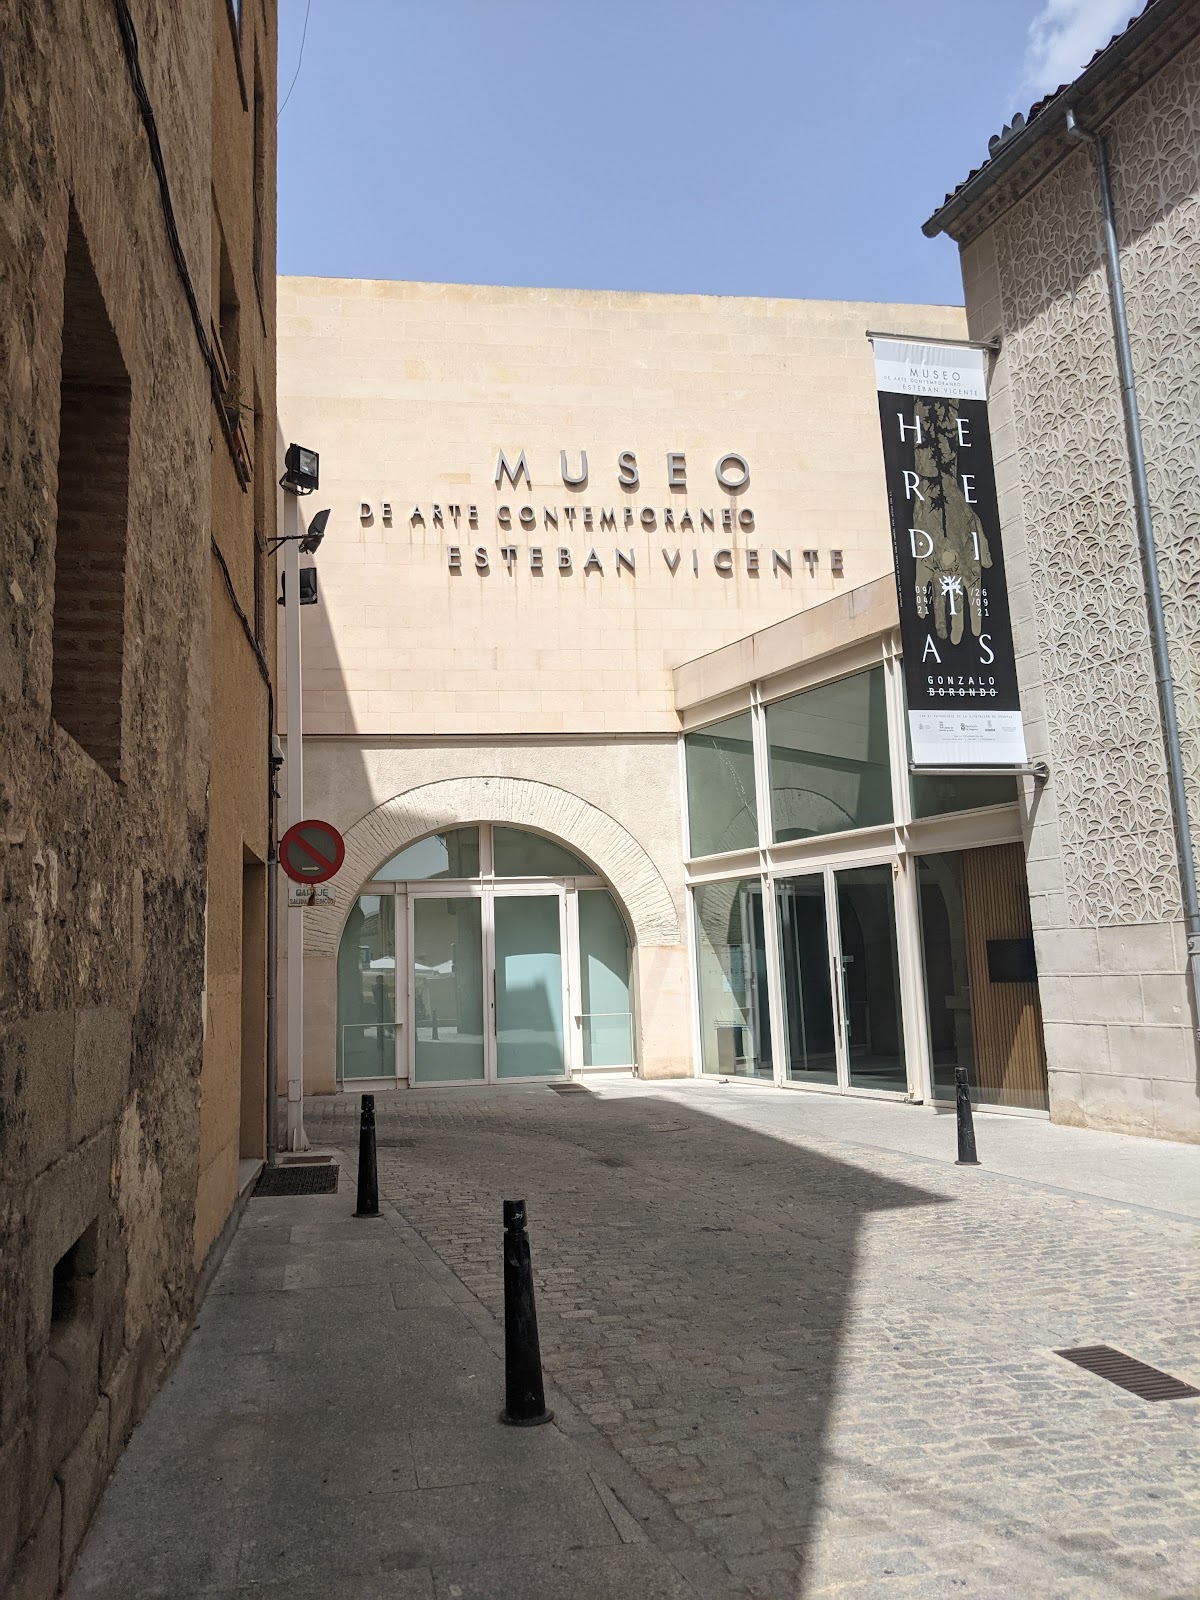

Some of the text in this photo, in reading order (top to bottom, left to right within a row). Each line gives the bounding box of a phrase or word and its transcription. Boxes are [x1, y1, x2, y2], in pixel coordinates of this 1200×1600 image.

[909, 368, 961, 382] MUSEO
[902, 384, 978, 397] ESTEBAN VICENTE
[494, 448, 750, 489] MUSEO
[359, 502, 755, 526] DE ARTE CONTEMPORANEO
[447, 545, 844, 573] ESTEBAN VICENTE
[917, 606, 990, 617] 21 21
[927, 675, 996, 686] GONZALO
[927, 687, 998, 697] BORONDO
[296, 888, 329, 897] GARJE
